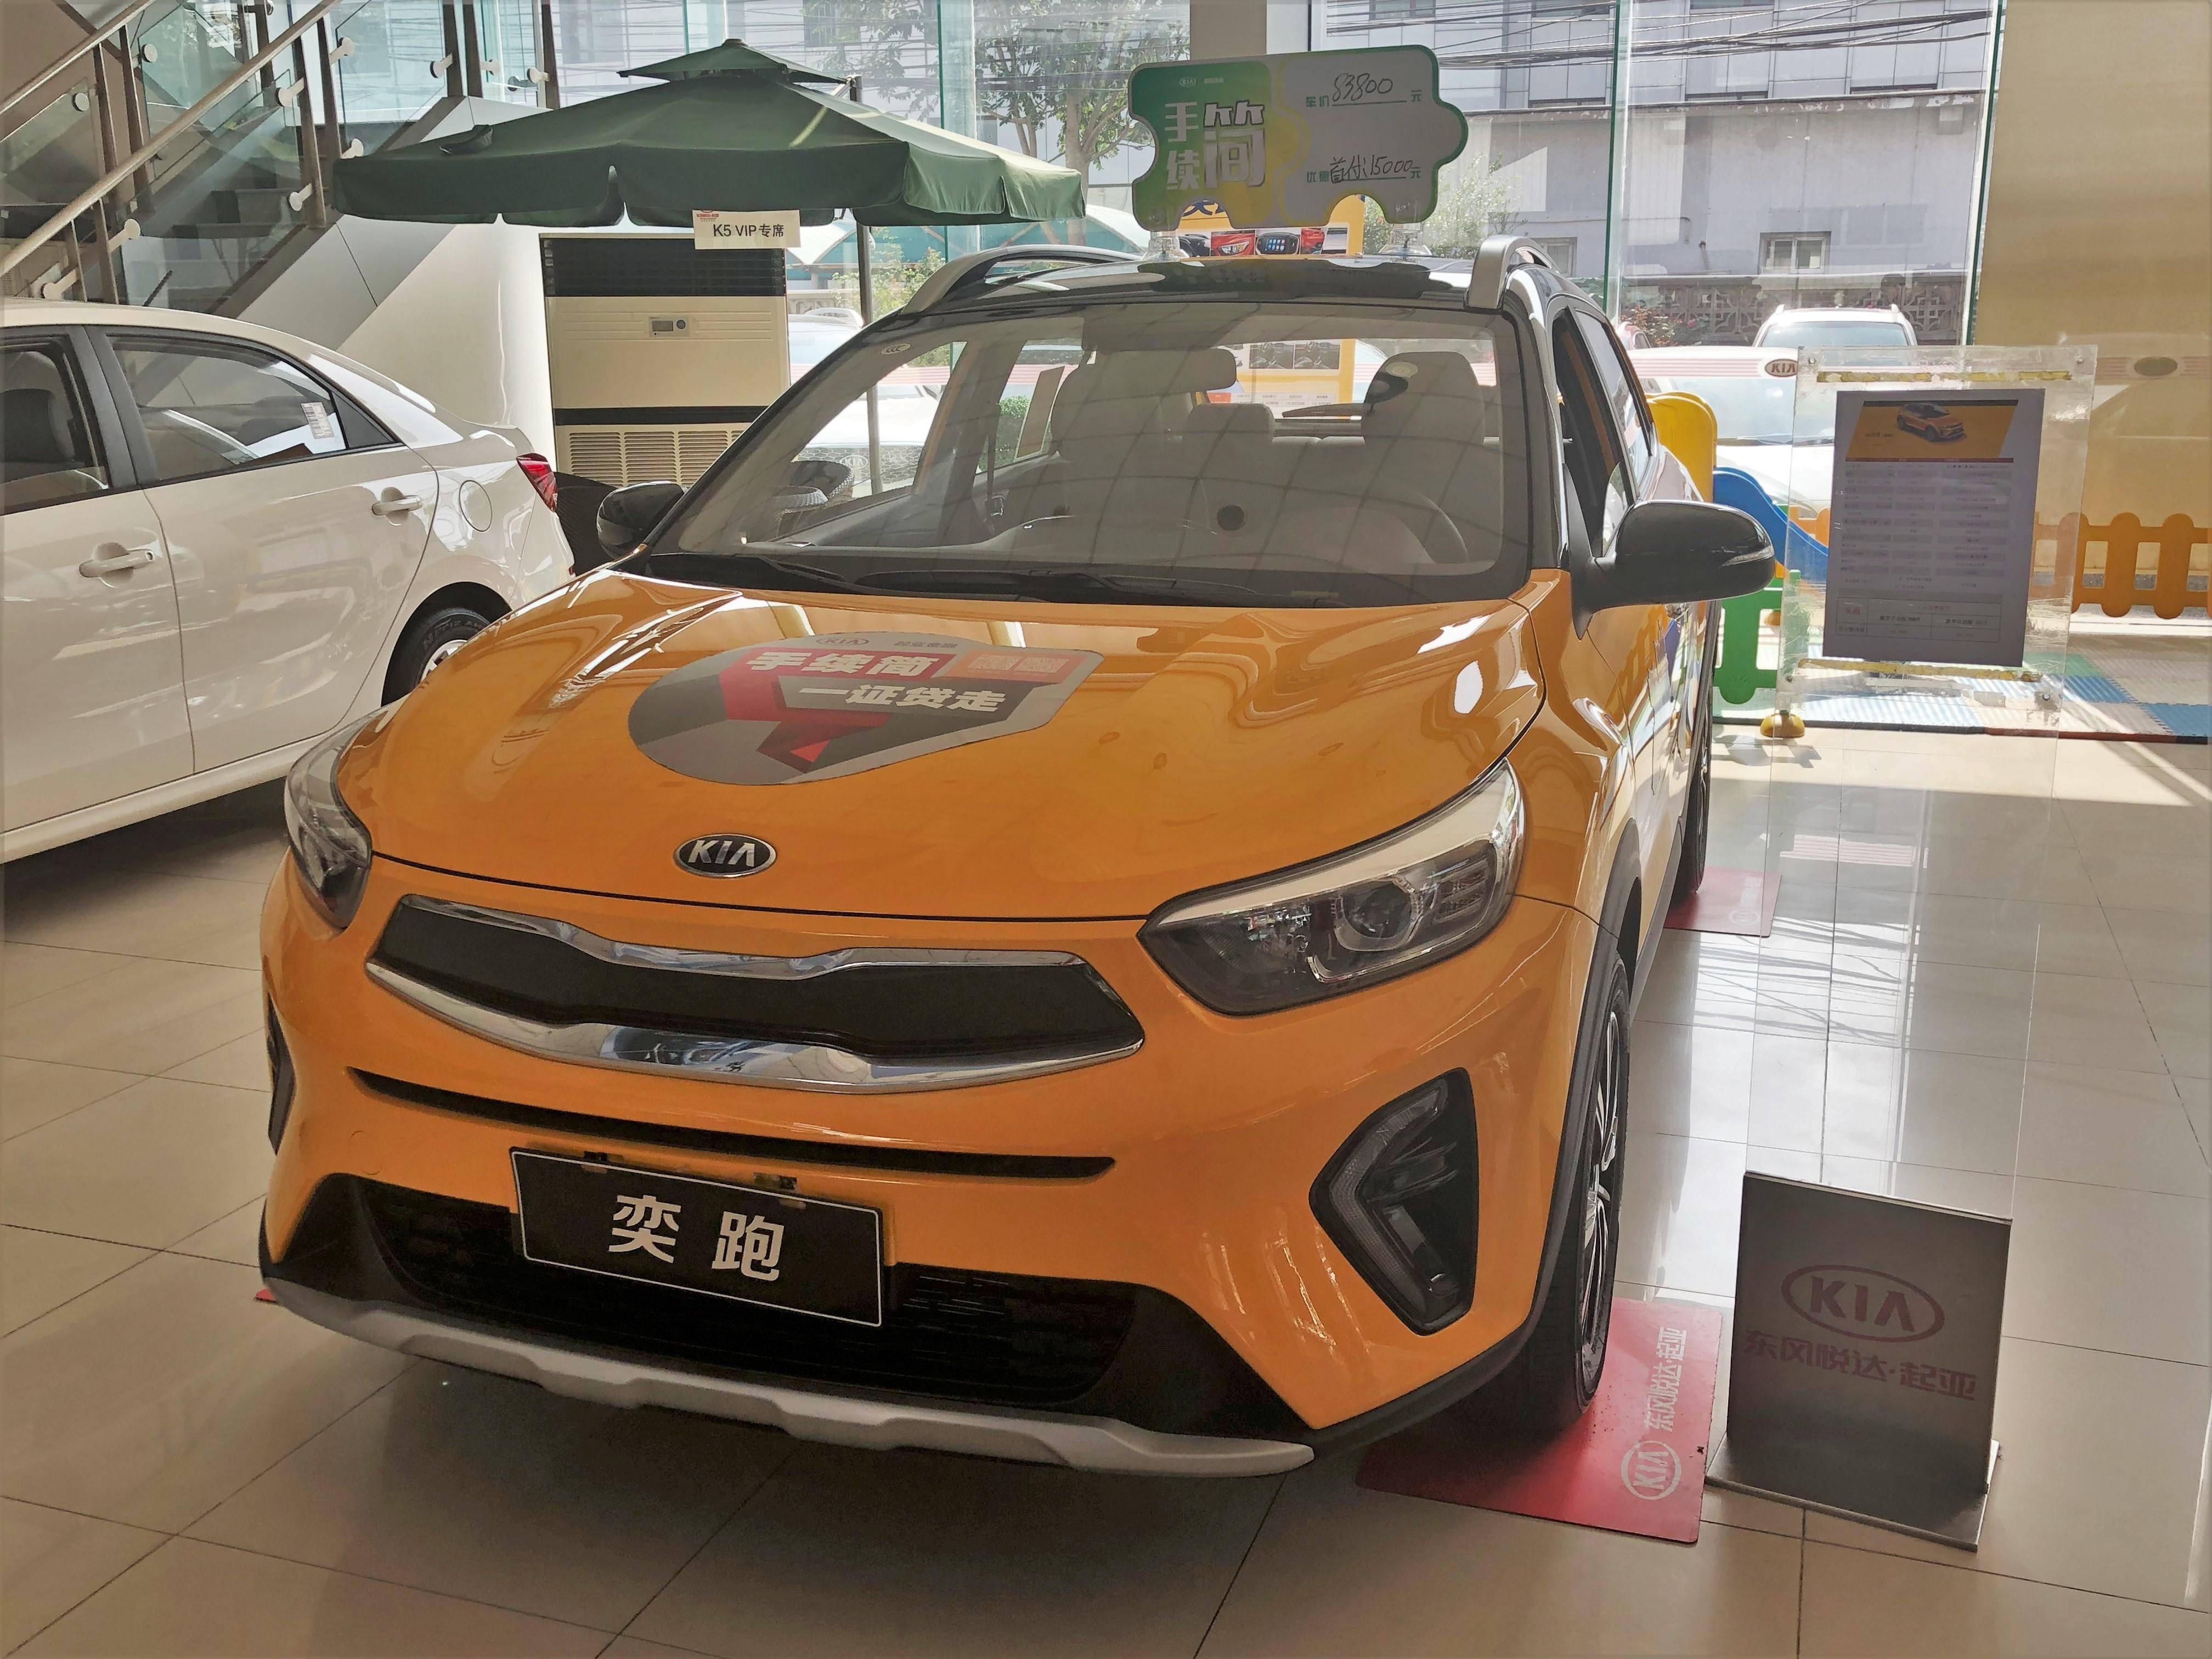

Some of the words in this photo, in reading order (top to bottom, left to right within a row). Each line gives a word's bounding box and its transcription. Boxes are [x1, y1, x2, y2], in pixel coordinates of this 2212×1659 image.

[1306, 95, 1329, 107] 车价
[1332, 73, 1393, 102] 83800
[1411, 89, 1422, 102] 元
[1410, 166, 1421, 178] 元
[713, 224, 731, 237] K5
[1771, 363, 1796, 373] KIA
[746, 651, 939, 676] 手续简
[799, 684, 1006, 713] 一证贷走
[688, 840, 755, 867] KIA
[1810, 1276, 1915, 1332] KIA
[1633, 1451, 1669, 1490] KIA
